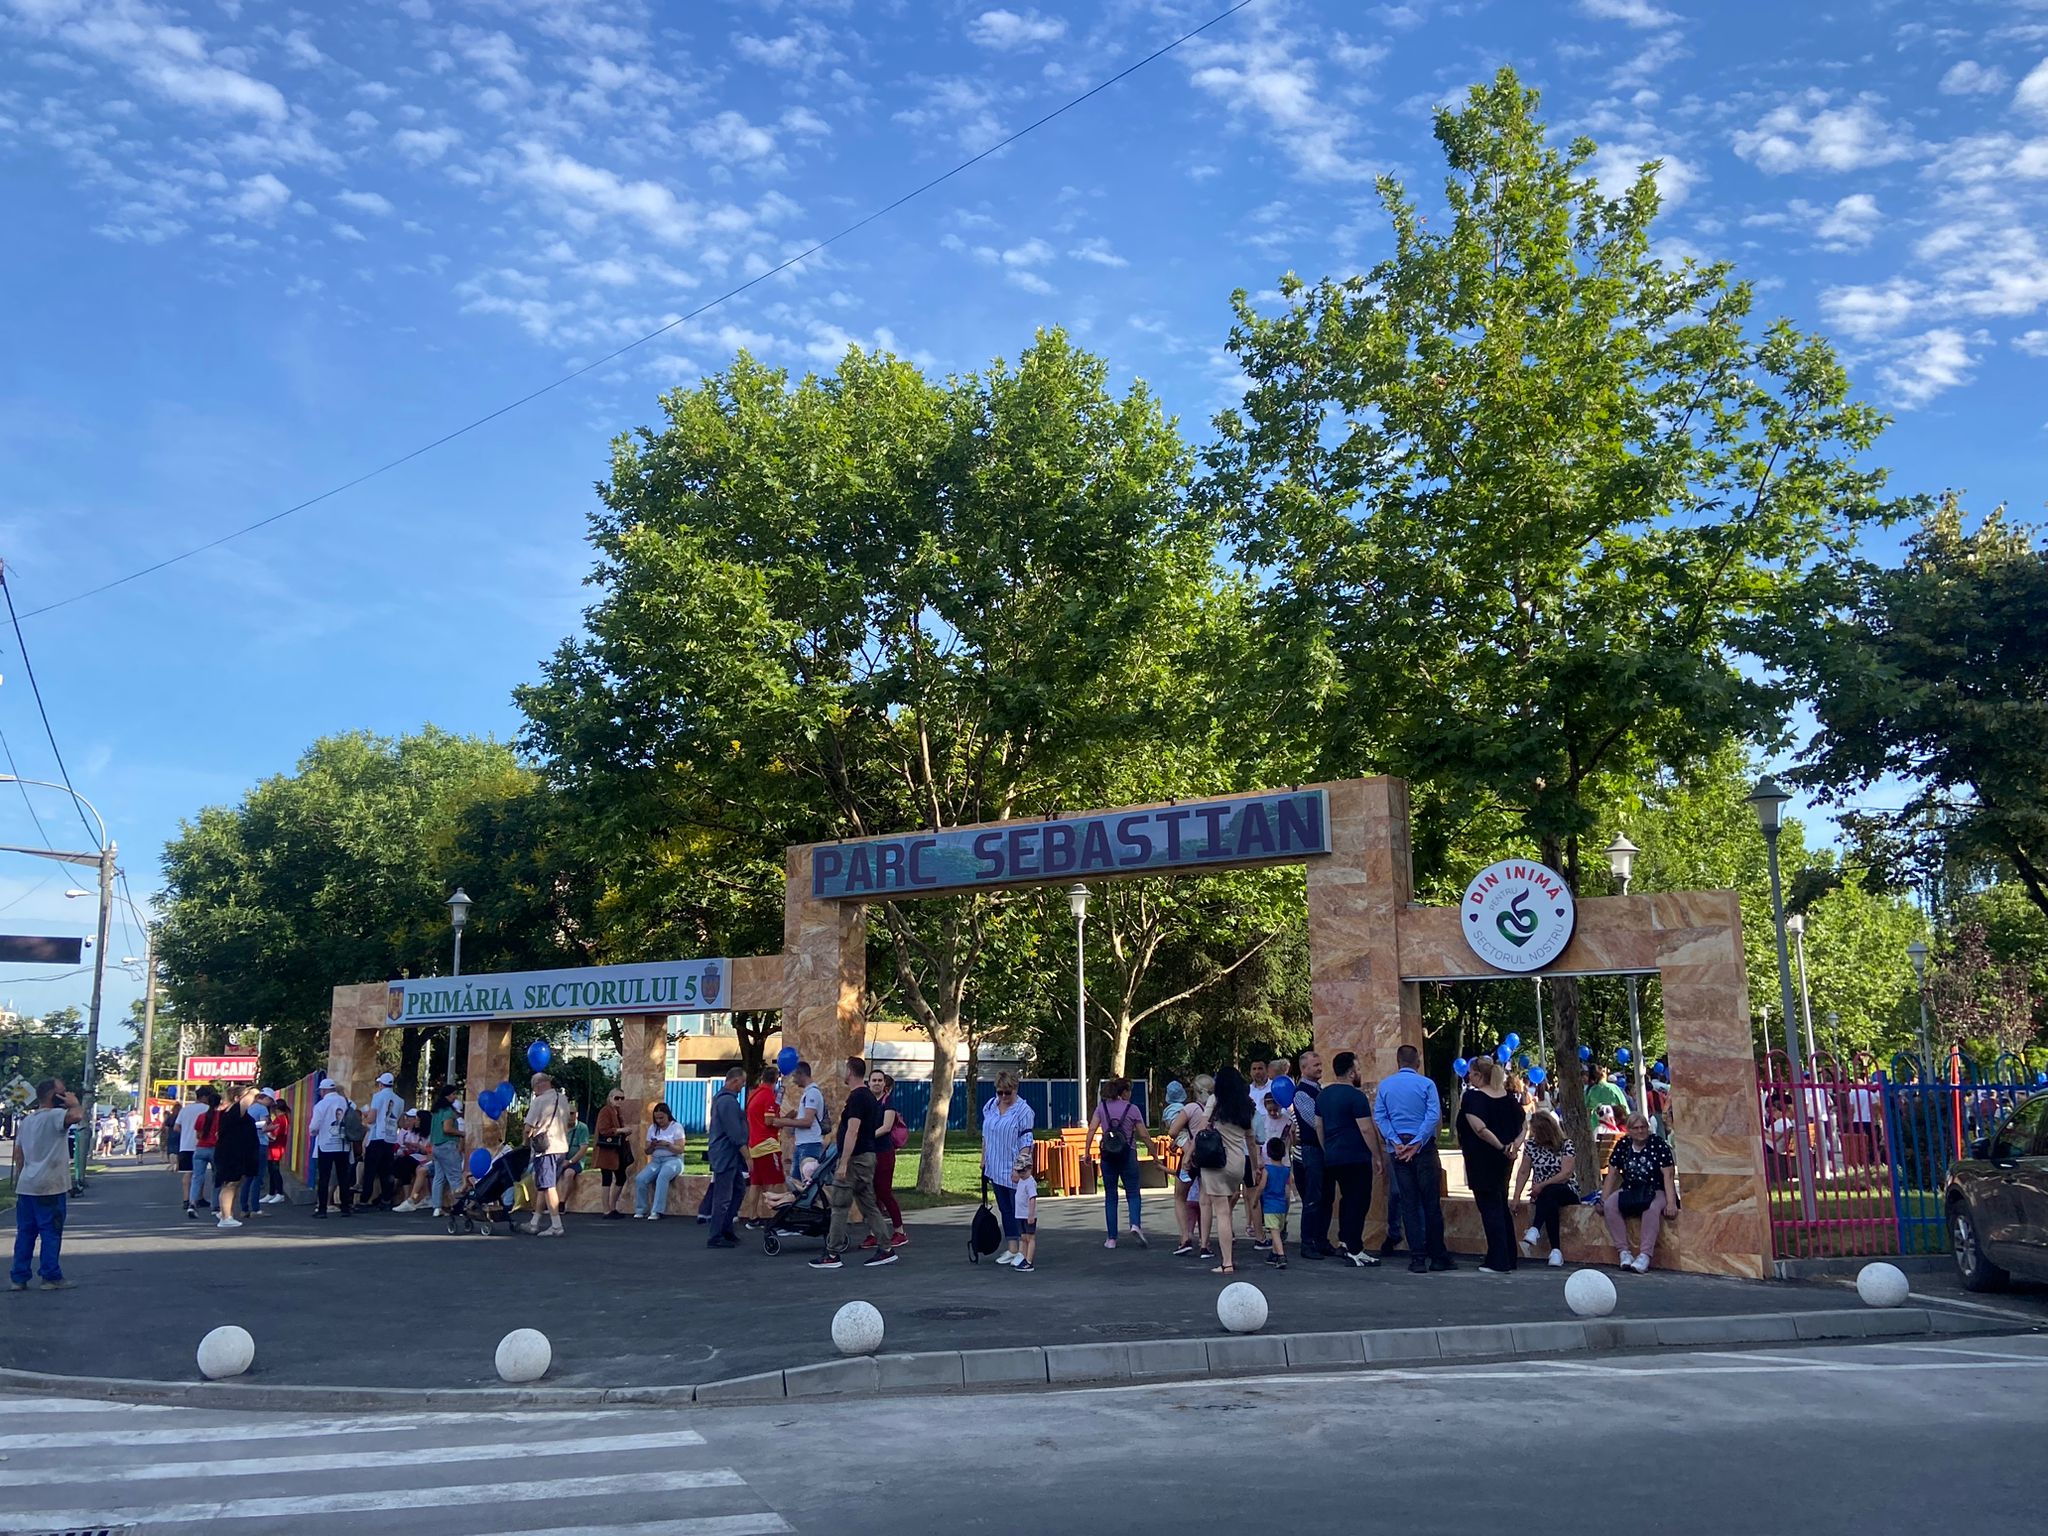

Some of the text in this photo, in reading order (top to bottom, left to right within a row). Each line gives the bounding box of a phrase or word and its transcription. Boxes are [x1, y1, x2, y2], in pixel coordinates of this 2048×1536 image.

[814, 797, 1322, 894] PARC SEBASTIAN
[1470, 865, 1564, 904] DIN INIMĂ
[1488, 887, 1518, 911] PENTRU
[1473, 924, 1564, 965] SECTORUL NOSTRU
[406, 975, 698, 1016] PRIMĂRIA SECTORULUI 5
